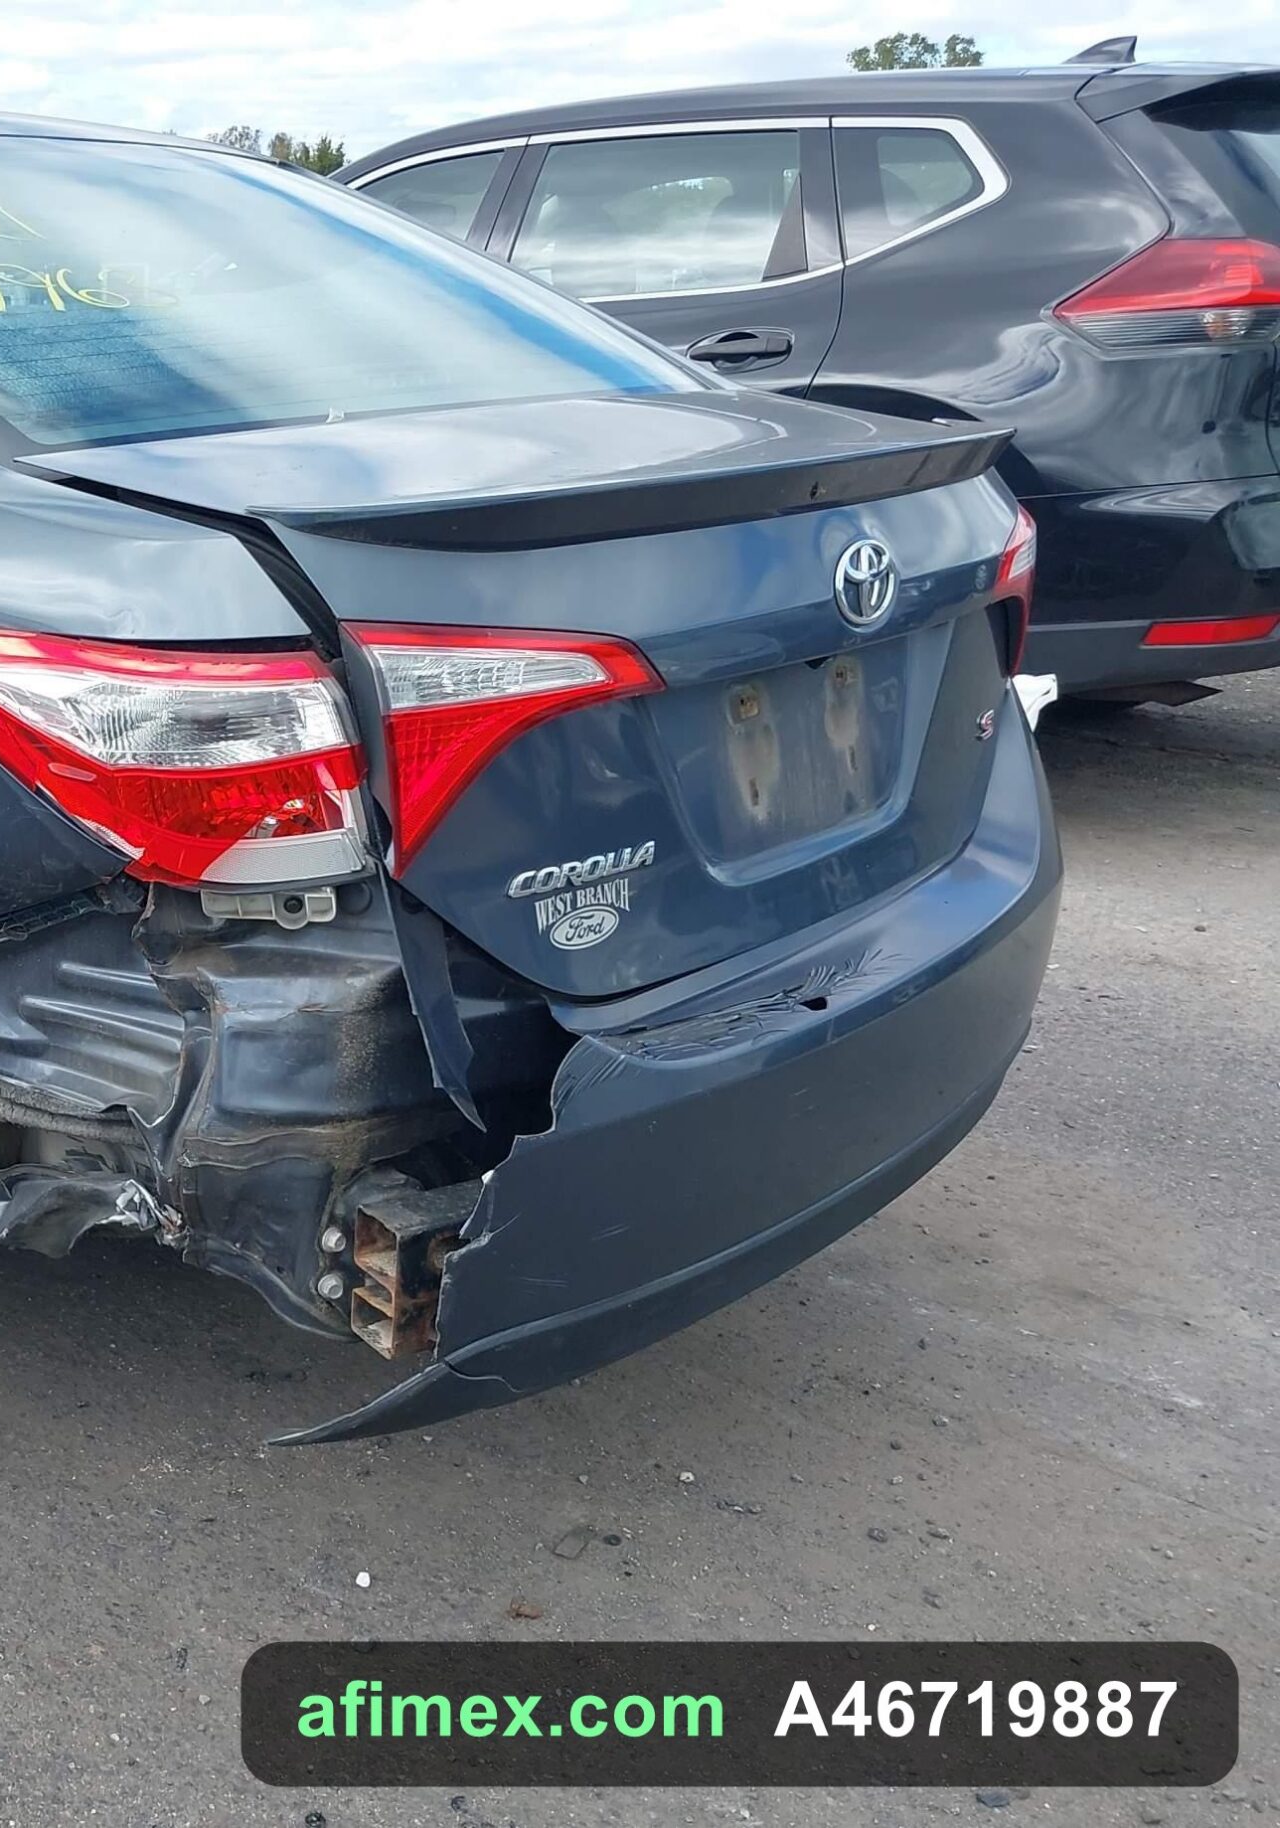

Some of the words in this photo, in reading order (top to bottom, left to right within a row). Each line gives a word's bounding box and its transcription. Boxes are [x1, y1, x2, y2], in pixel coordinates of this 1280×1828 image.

[506, 840, 655, 898] COROLLA
[534, 892, 574, 936] WEST
[576, 878, 630, 912] BRANCH
[565, 913, 606, 942] Ford
